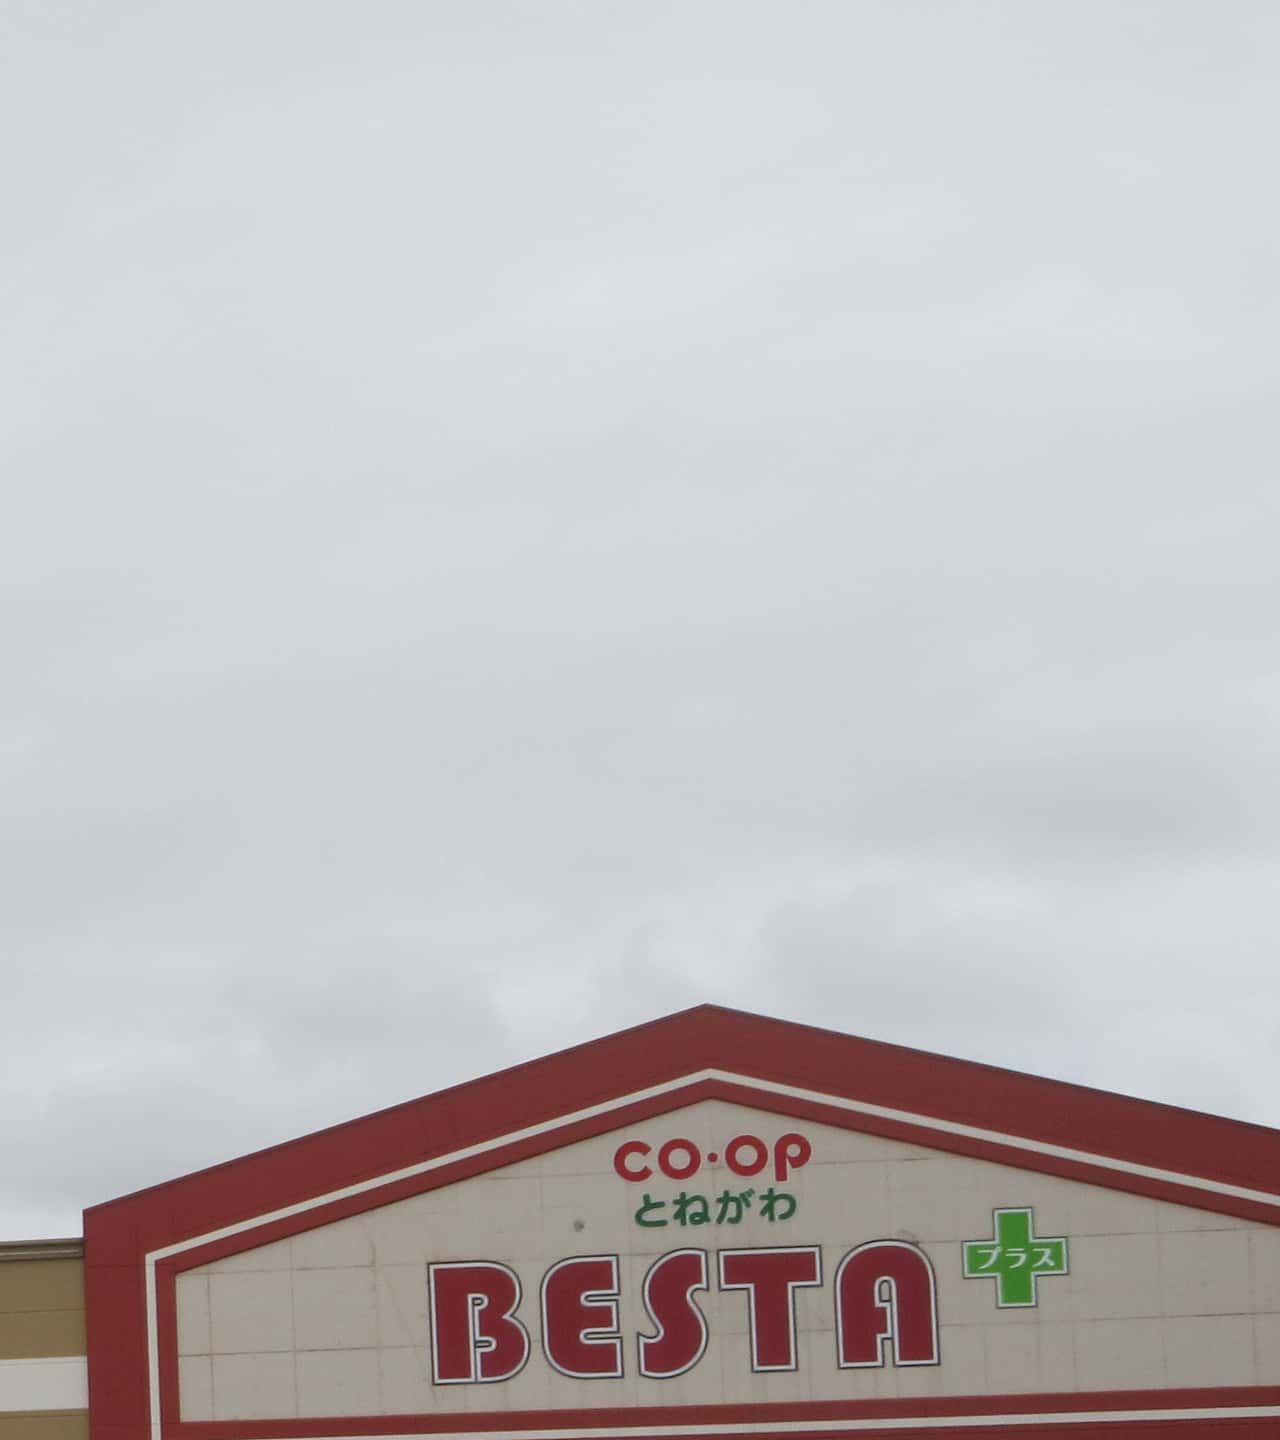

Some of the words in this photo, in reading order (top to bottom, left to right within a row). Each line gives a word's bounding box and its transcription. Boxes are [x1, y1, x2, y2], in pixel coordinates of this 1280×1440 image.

[635, 1187, 797, 1228] とねがわ
[976, 1245, 1056, 1270] プラス
[427, 1239, 941, 1386] BESTA
